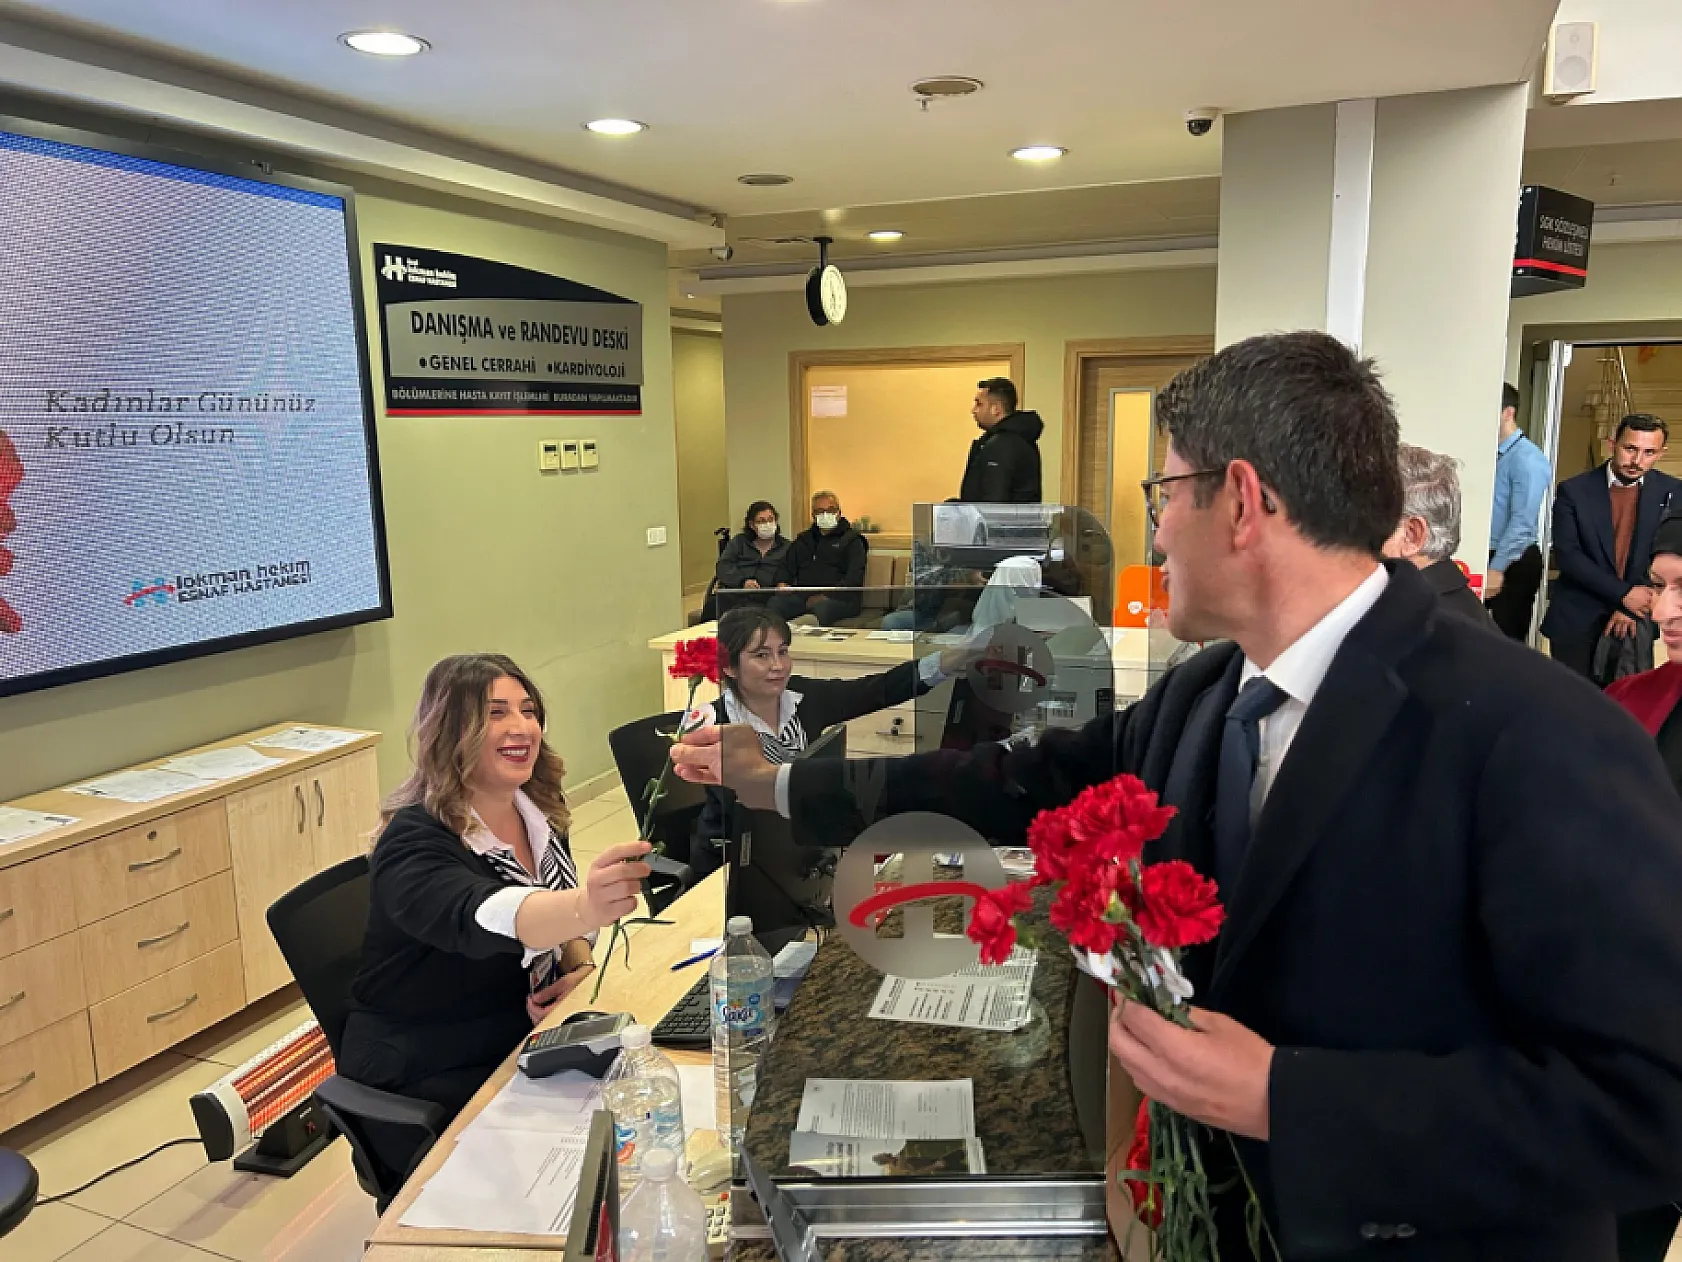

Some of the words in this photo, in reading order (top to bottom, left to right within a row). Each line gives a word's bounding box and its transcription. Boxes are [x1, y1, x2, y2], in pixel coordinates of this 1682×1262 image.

[410, 310, 495, 344] DANIŞMA
[498, 324, 516, 341] ve
[520, 320, 588, 347] RANDEVU
[592, 326, 628, 350] DESKİ
[430, 354, 478, 371] GENEL
[481, 356, 536, 374] CERRAHİ
[553, 358, 625, 378] KARDİYOLOJİ
[46, 388, 190, 413] Kadınlar
[198, 392, 316, 413] Gününüz
[459, 390, 488, 400] HASTA
[46, 422, 138, 448] Kutlu
[151, 421, 235, 445] Olsun
[176, 569, 250, 589] lokman
